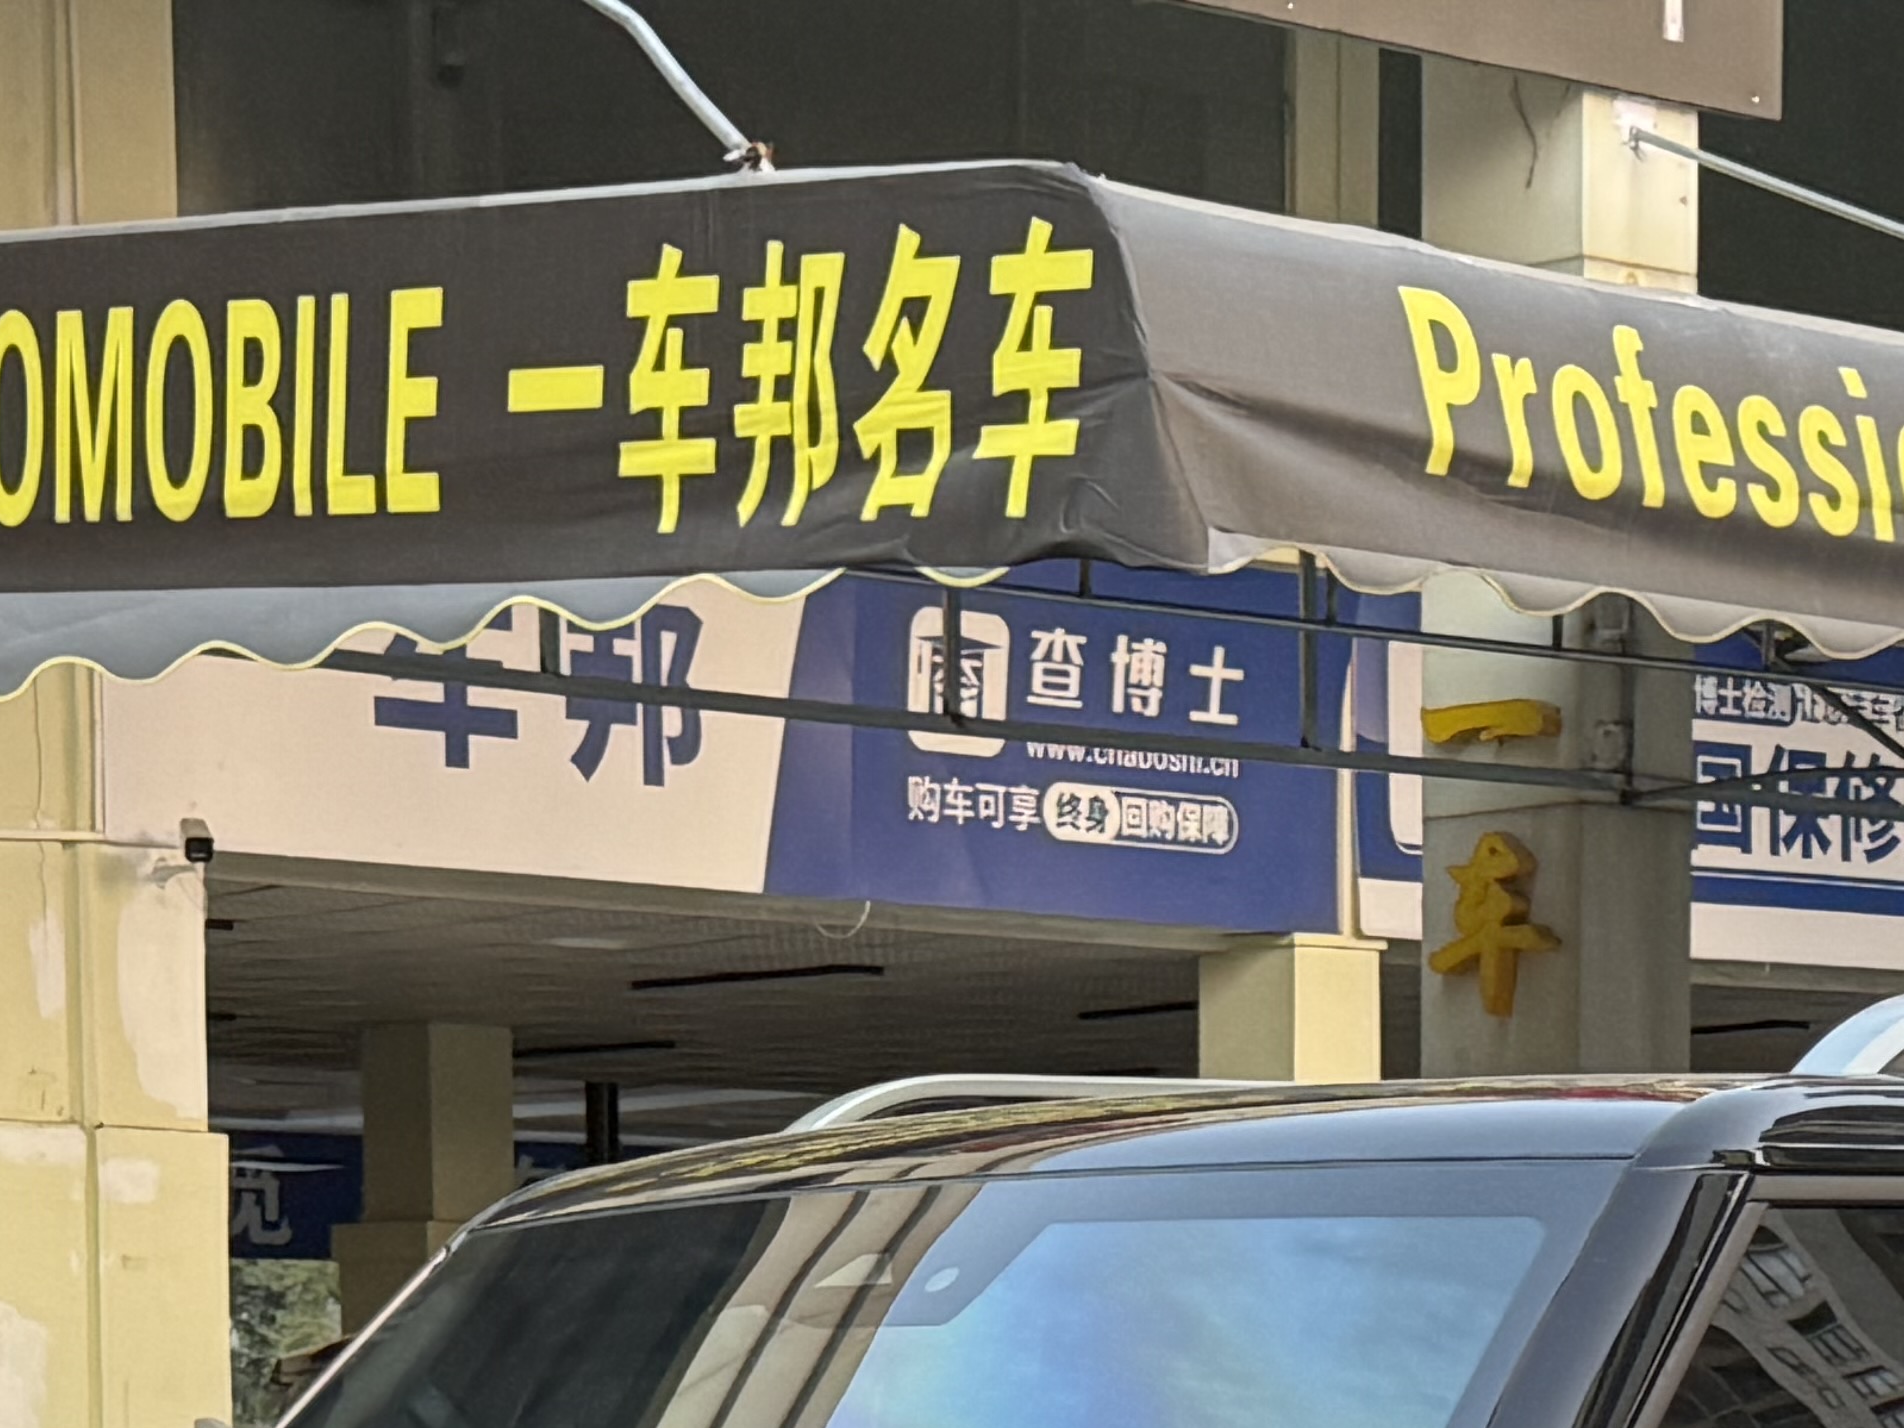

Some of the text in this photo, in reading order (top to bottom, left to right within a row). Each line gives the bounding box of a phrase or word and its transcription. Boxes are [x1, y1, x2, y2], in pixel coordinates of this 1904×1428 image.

[507, 216, 1094, 534] 一车邦名车
[1027, 627, 1245, 726] 查博士
